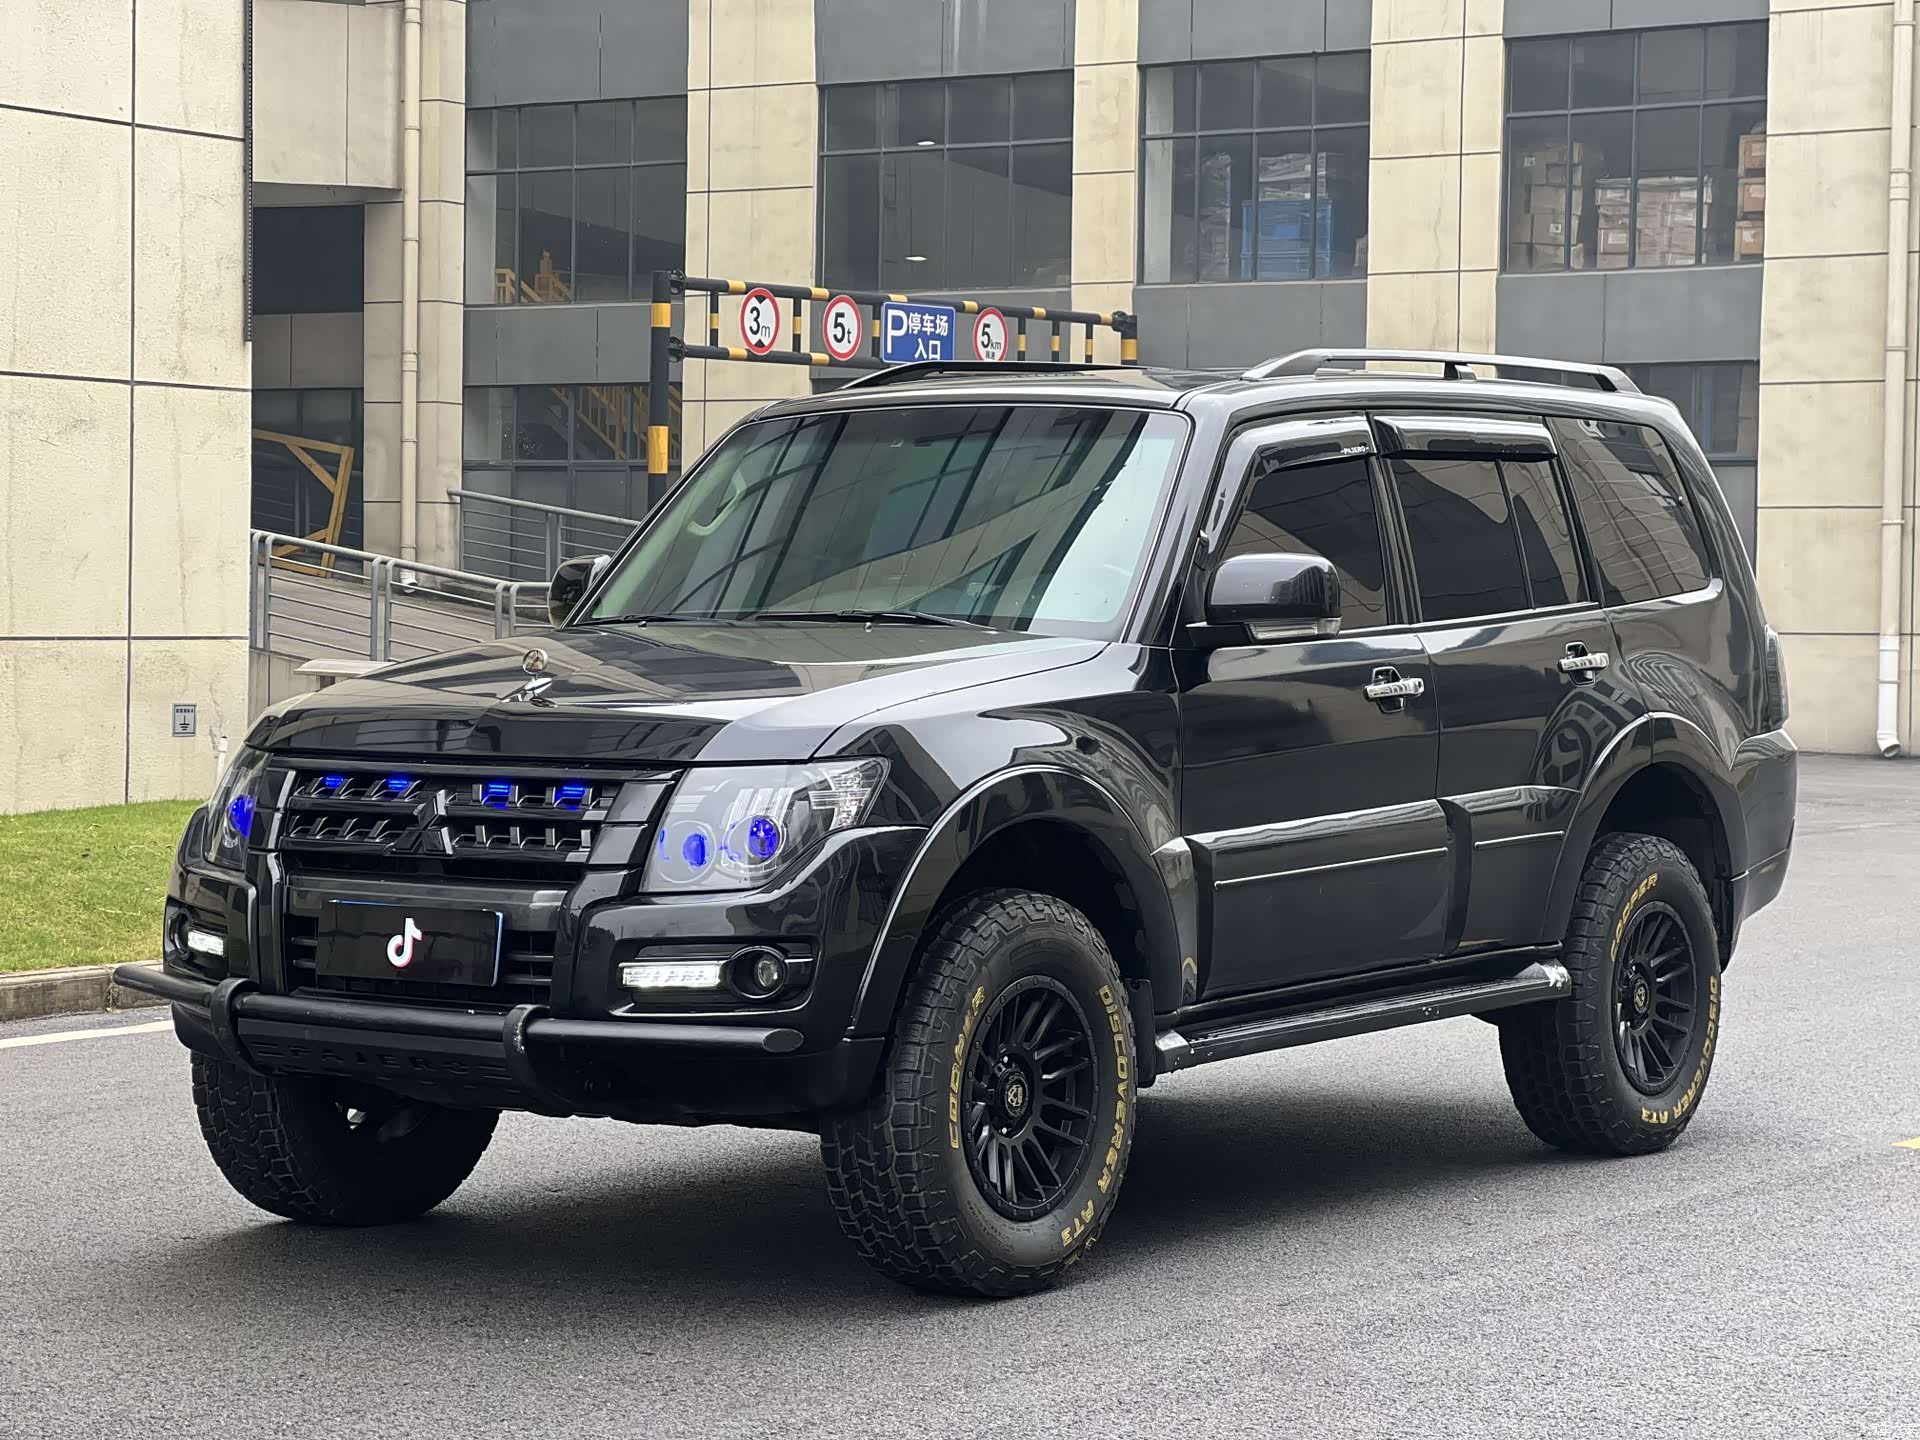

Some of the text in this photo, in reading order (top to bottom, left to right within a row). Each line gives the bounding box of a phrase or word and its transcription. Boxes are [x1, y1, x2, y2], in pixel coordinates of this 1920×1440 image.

[749, 306, 771, 338] 3m
[833, 311, 852, 344] 5t
[887, 309, 908, 354] P
[908, 312, 949, 337] 停车场
[981, 323, 1002, 350] 5km
[914, 338, 941, 360] 入口
[1610, 872, 1658, 961] COOPER
[1641, 975, 1717, 1124] DISCOVERER AT3
[1061, 984, 1128, 1247] DISCOVERER AT3
